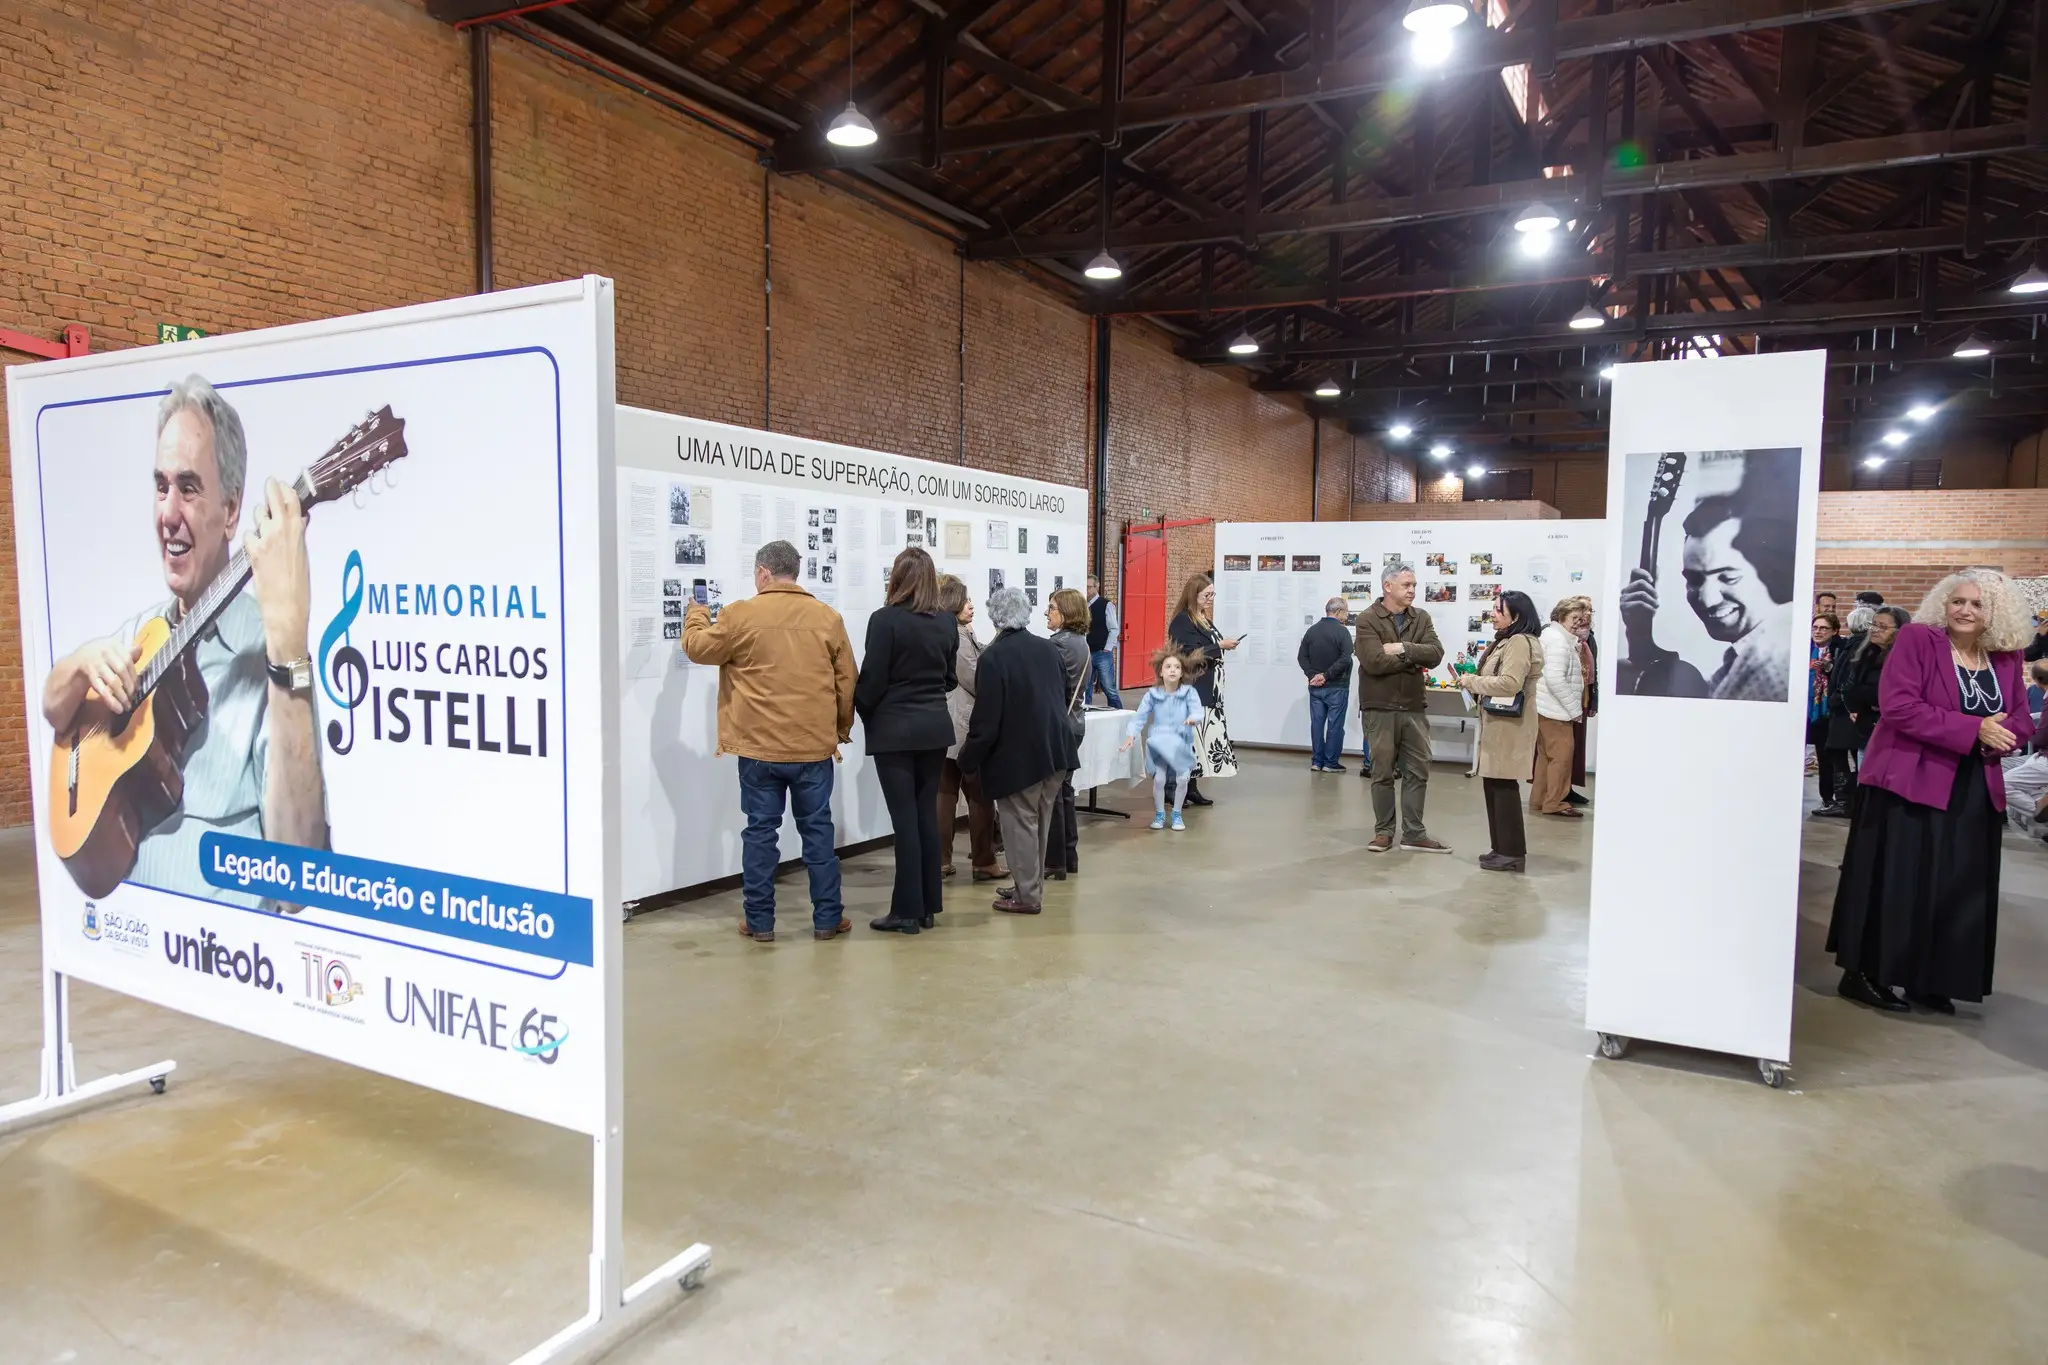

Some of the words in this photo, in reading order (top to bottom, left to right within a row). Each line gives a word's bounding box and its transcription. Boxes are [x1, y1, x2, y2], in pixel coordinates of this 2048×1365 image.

[677, 435, 726, 466] UMA
[730, 444, 776, 473] VIDA
[781, 452, 806, 477] DE
[811, 457, 914, 495] SUPERAÇÃO,
[917, 474, 949, 498] COM
[952, 480, 971, 501] UM
[974, 483, 1027, 509] SORRISO
[1029, 493, 1065, 513] LARGO
[368, 583, 547, 619] MEMORIAL
[372, 640, 428, 673] LUIS
[436, 643, 548, 680] CARLOS
[213, 845, 297, 891] Legado,
[301, 861, 414, 911] Educação
[420, 890, 436, 915] e
[441, 887, 555, 939] Inclusão
[104, 911, 122, 929] SÃO
[125, 918, 149, 937] JOÃO
[385, 976, 507, 1051] UNIFAE
[519, 1007, 559, 1065] 65
